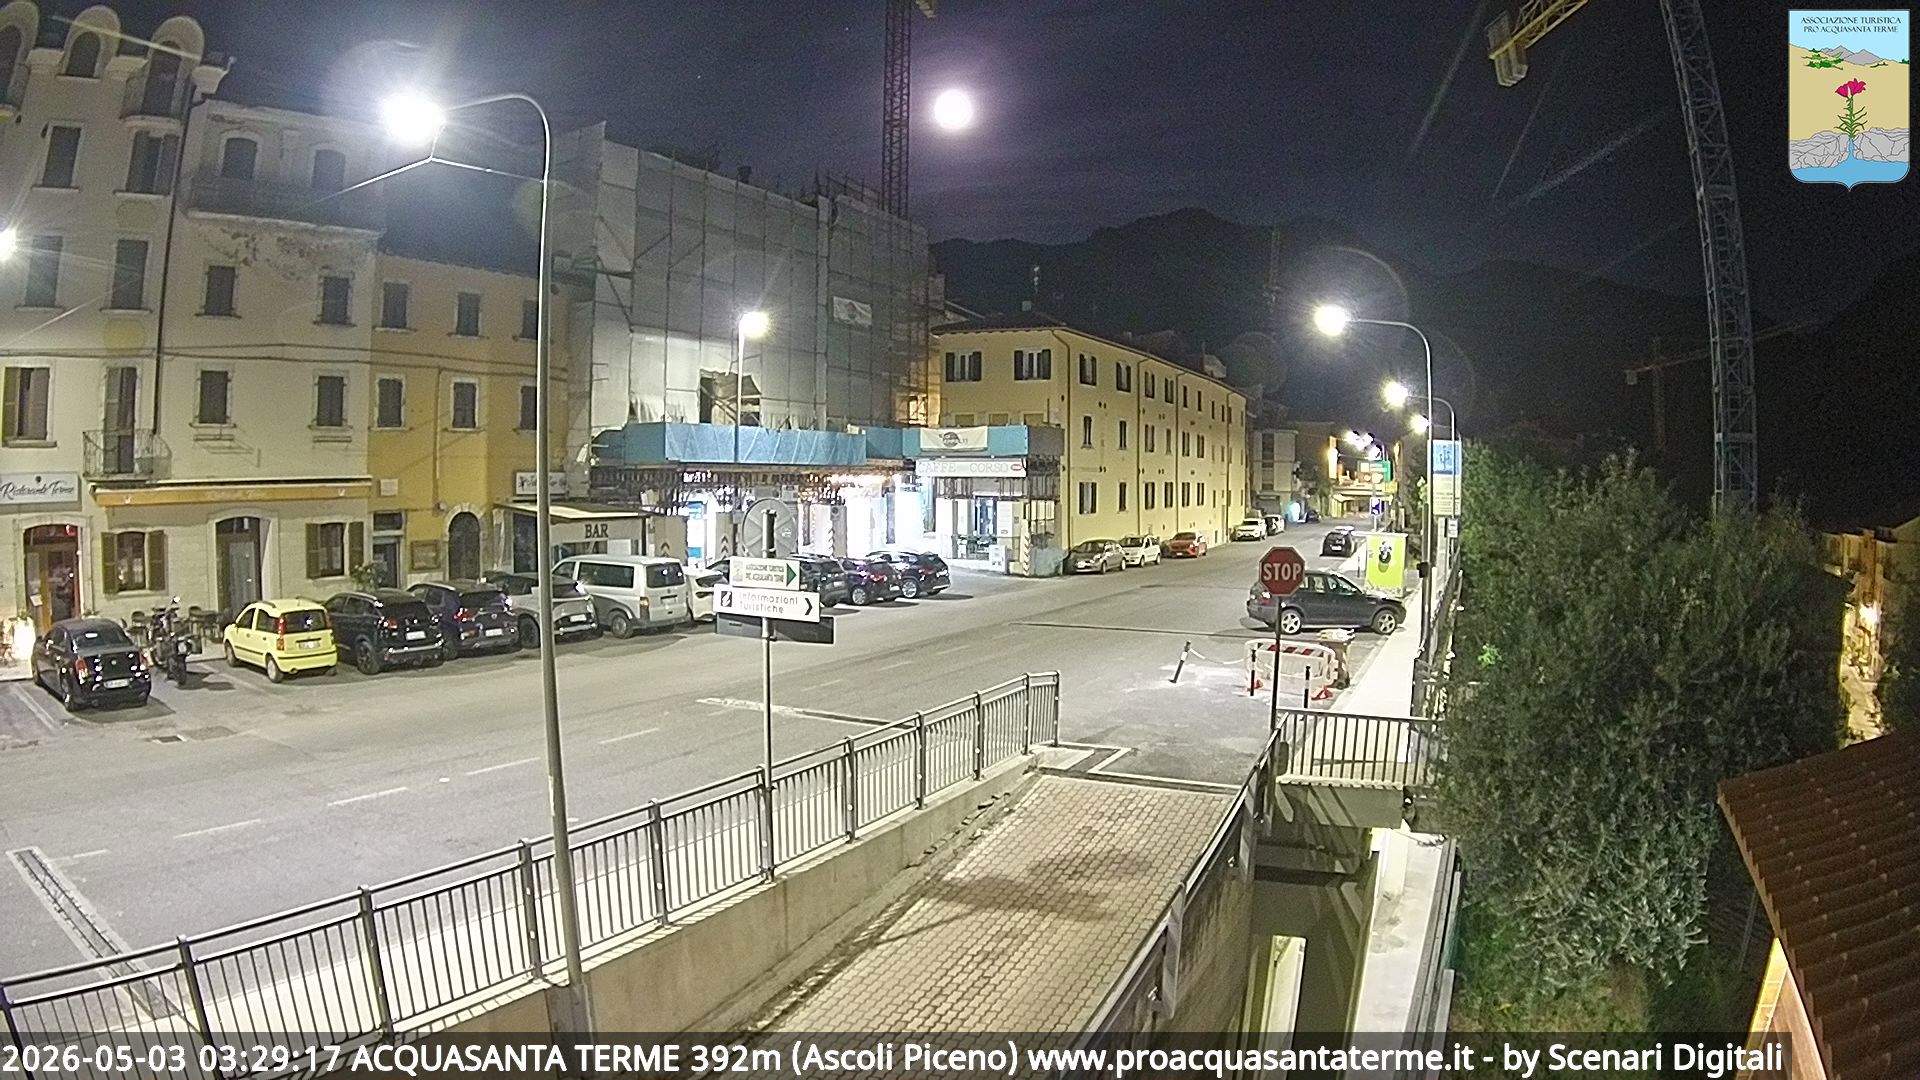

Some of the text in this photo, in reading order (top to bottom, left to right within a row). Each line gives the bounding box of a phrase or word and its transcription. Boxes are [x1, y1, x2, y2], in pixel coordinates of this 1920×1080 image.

[969, 462, 1009, 474] CORSO
[584, 523, 609, 539] BAR
[1263, 562, 1302, 581] STOP
[739, 590, 798, 605] Informazioni
[739, 600, 784, 614] Turistiche
